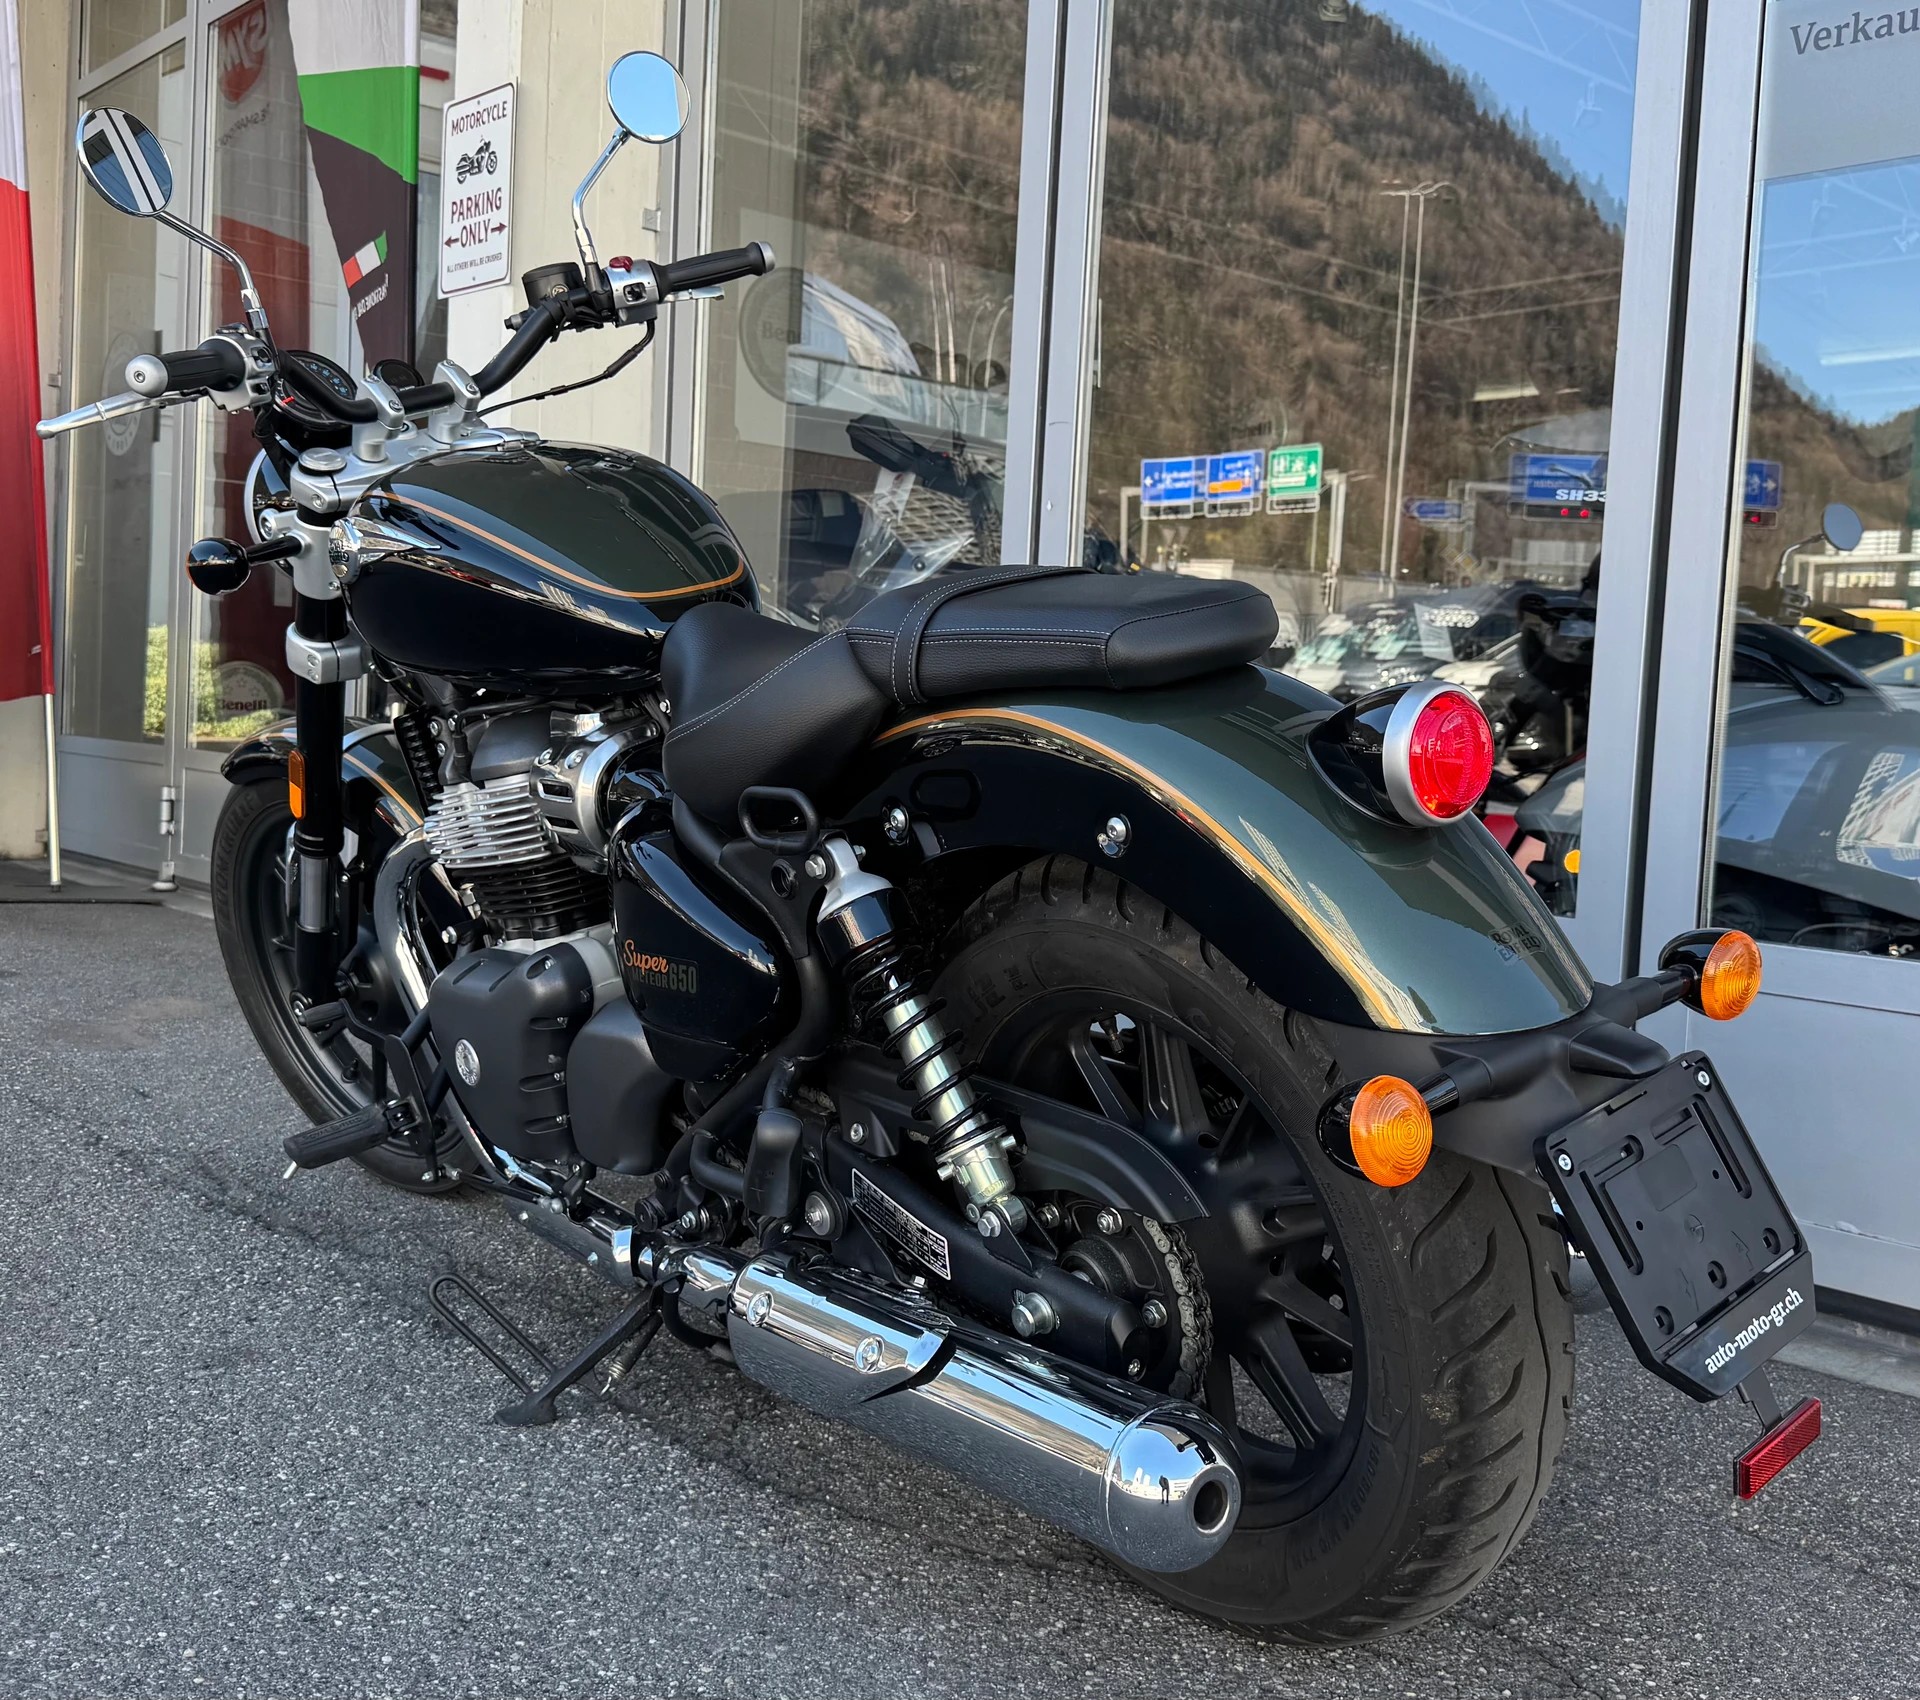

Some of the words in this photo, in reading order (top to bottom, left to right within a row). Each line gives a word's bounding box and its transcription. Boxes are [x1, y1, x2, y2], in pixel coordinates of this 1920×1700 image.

[1790, 8, 1920, 55] Verkau
[451, 101, 508, 136] MOTORCYCLE
[450, 187, 502, 224] PARKING
[460, 218, 491, 248] ONLY
[1492, 925, 1530, 945] ROYAL
[623, 939, 669, 976] Super
[631, 965, 669, 989] METEOR
[669, 962, 697, 994] 650
[1704, 1287, 1804, 1374] auto-moto-gr.ch
